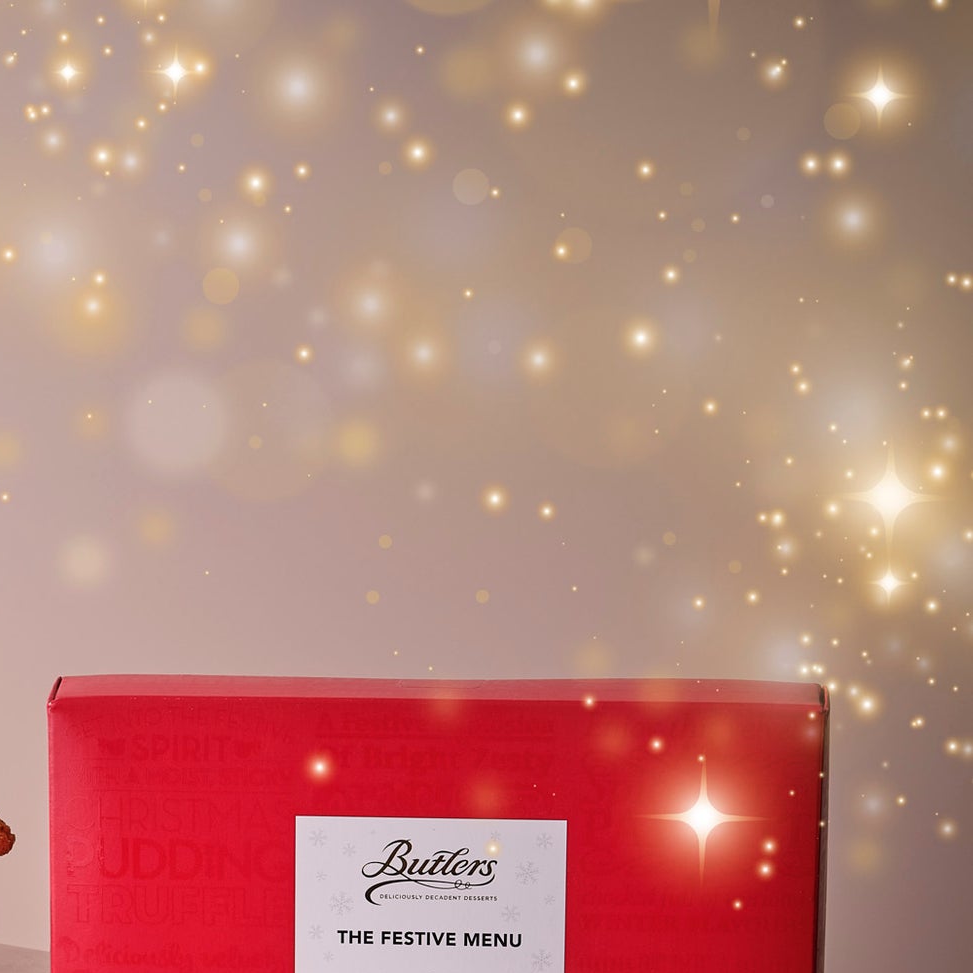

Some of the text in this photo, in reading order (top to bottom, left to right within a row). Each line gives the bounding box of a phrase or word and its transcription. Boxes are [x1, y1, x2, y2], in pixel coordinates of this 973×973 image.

[361, 839, 498, 887] Butlers
[337, 930, 522, 948] THE FESTIVE MENU
